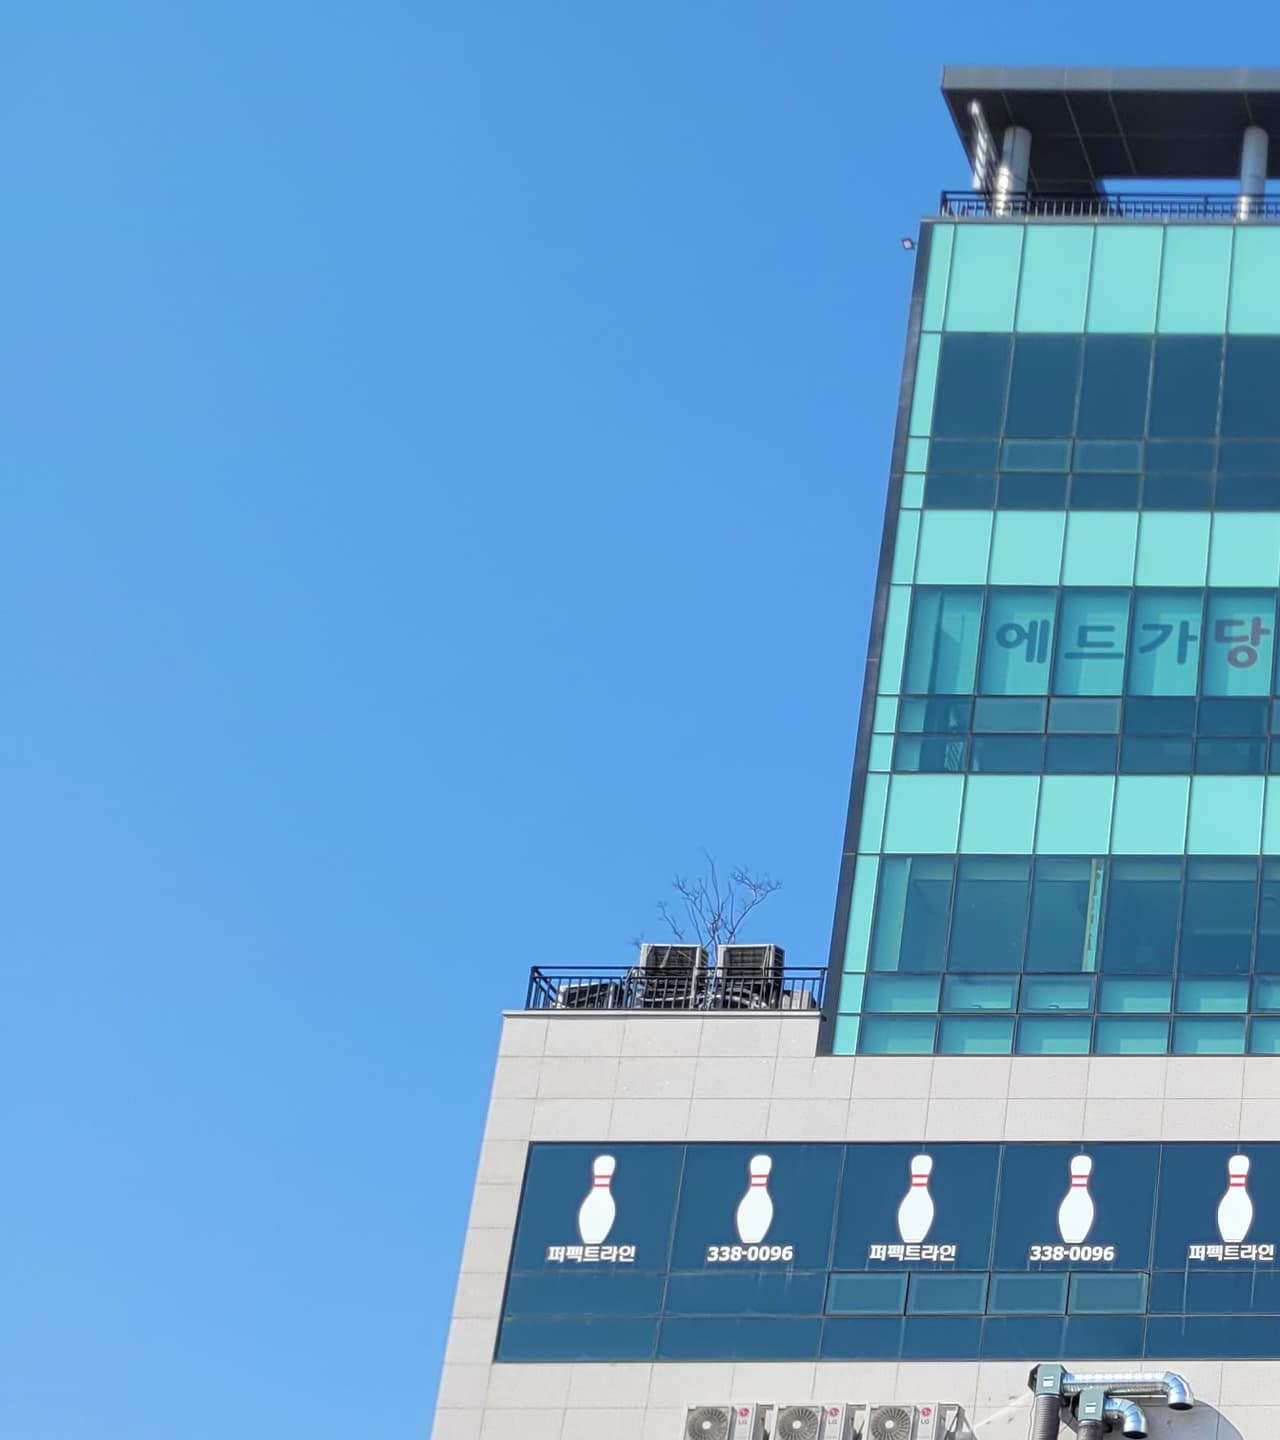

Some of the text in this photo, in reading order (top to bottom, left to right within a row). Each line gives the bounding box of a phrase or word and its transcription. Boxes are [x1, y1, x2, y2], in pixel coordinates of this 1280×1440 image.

[547, 1245, 637, 1263] 퍼펙트라인
[707, 1245, 794, 1263] 338-0096
[869, 1245, 957, 1262] 퍼펙트라인
[1029, 1245, 1116, 1262] 338-0096
[1188, 1244, 1275, 1262] 퍼펙트라인
